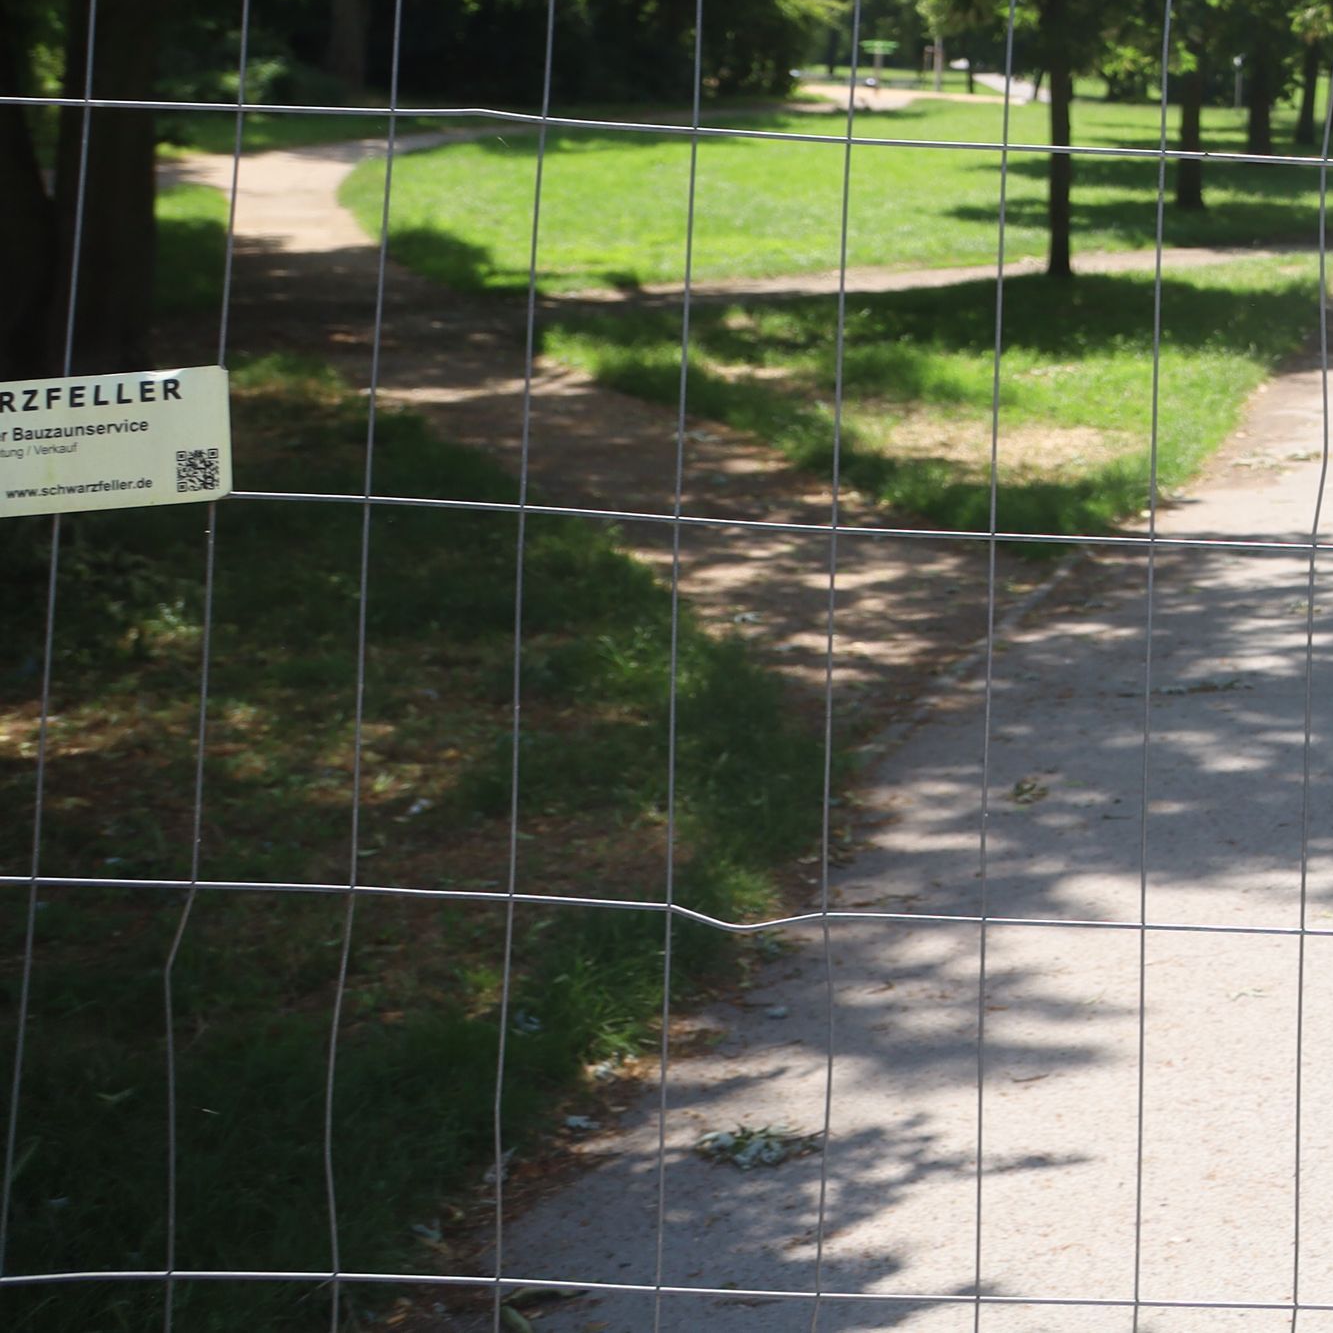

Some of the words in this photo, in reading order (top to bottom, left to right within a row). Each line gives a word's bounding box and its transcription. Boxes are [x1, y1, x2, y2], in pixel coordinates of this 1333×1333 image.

[12, 420, 148, 441] Bauzaunservice
[34, 442, 78, 454] Verkauf
[6, 478, 152, 498] www.schwarzfeller.de
